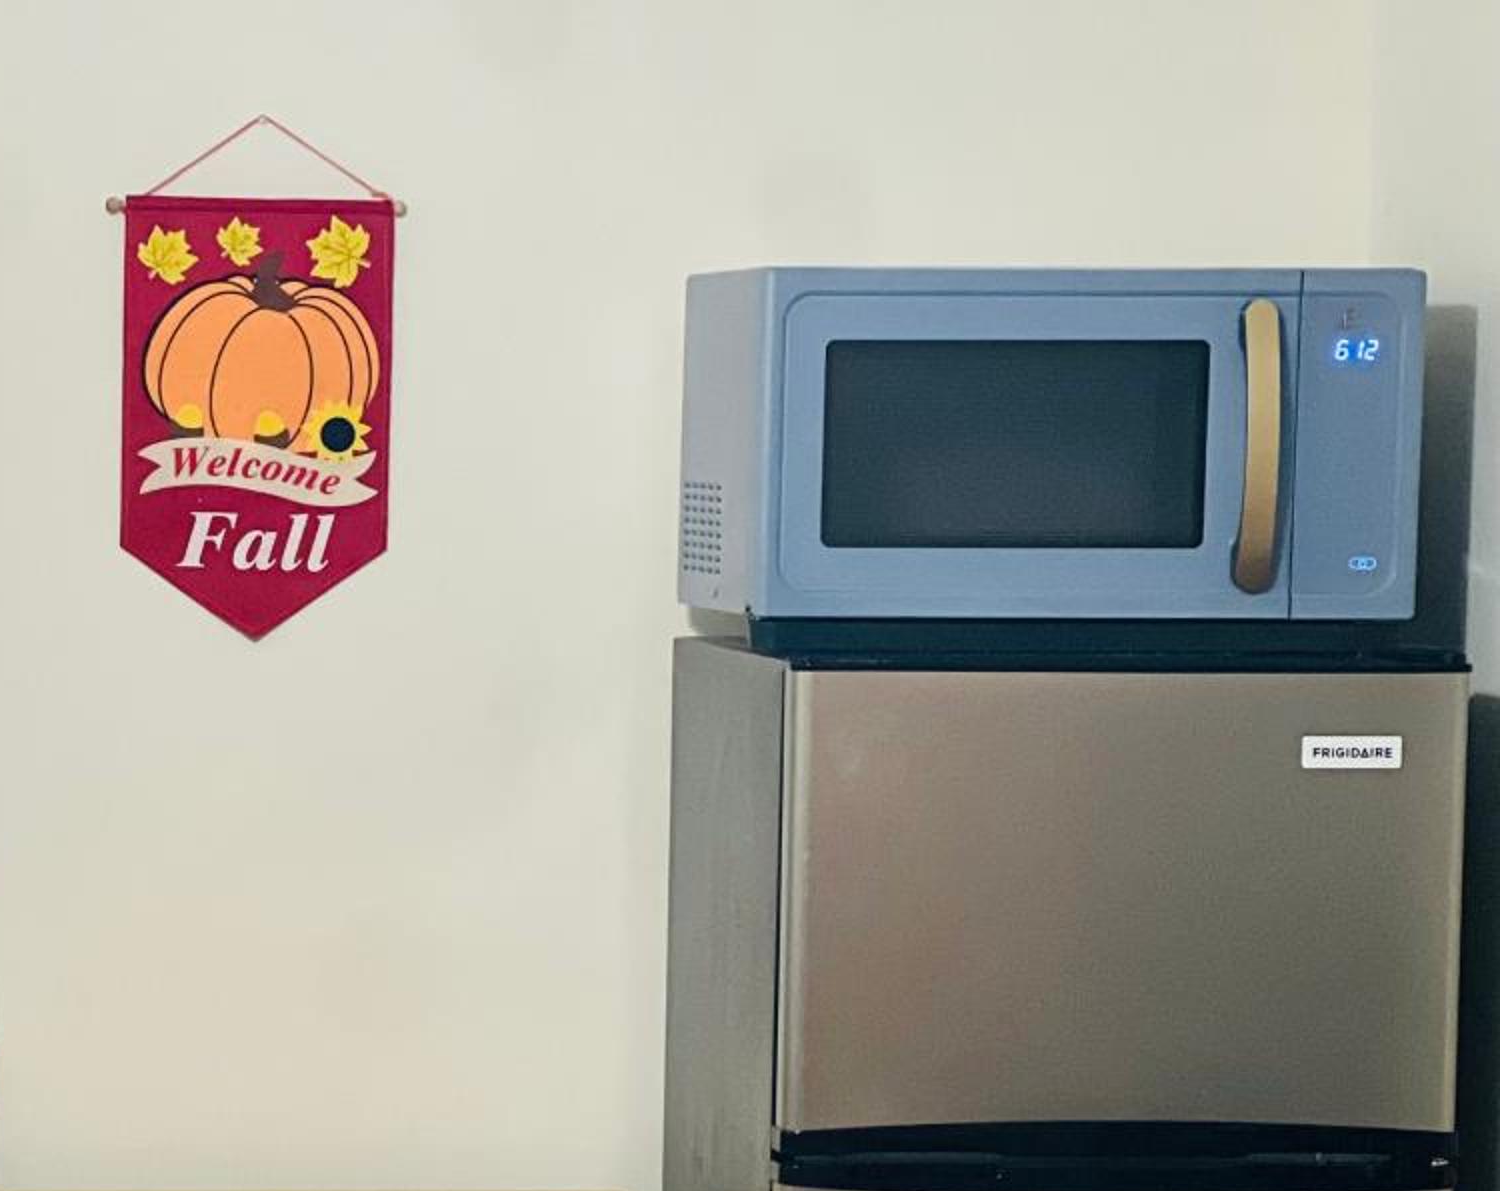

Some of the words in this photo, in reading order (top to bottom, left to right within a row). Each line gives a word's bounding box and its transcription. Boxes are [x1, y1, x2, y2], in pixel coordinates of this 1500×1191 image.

[171, 446, 342, 496] Welcome
[175, 511, 336, 573] Fall
[1313, 747, 1393, 759] FRIGIDAIRE
